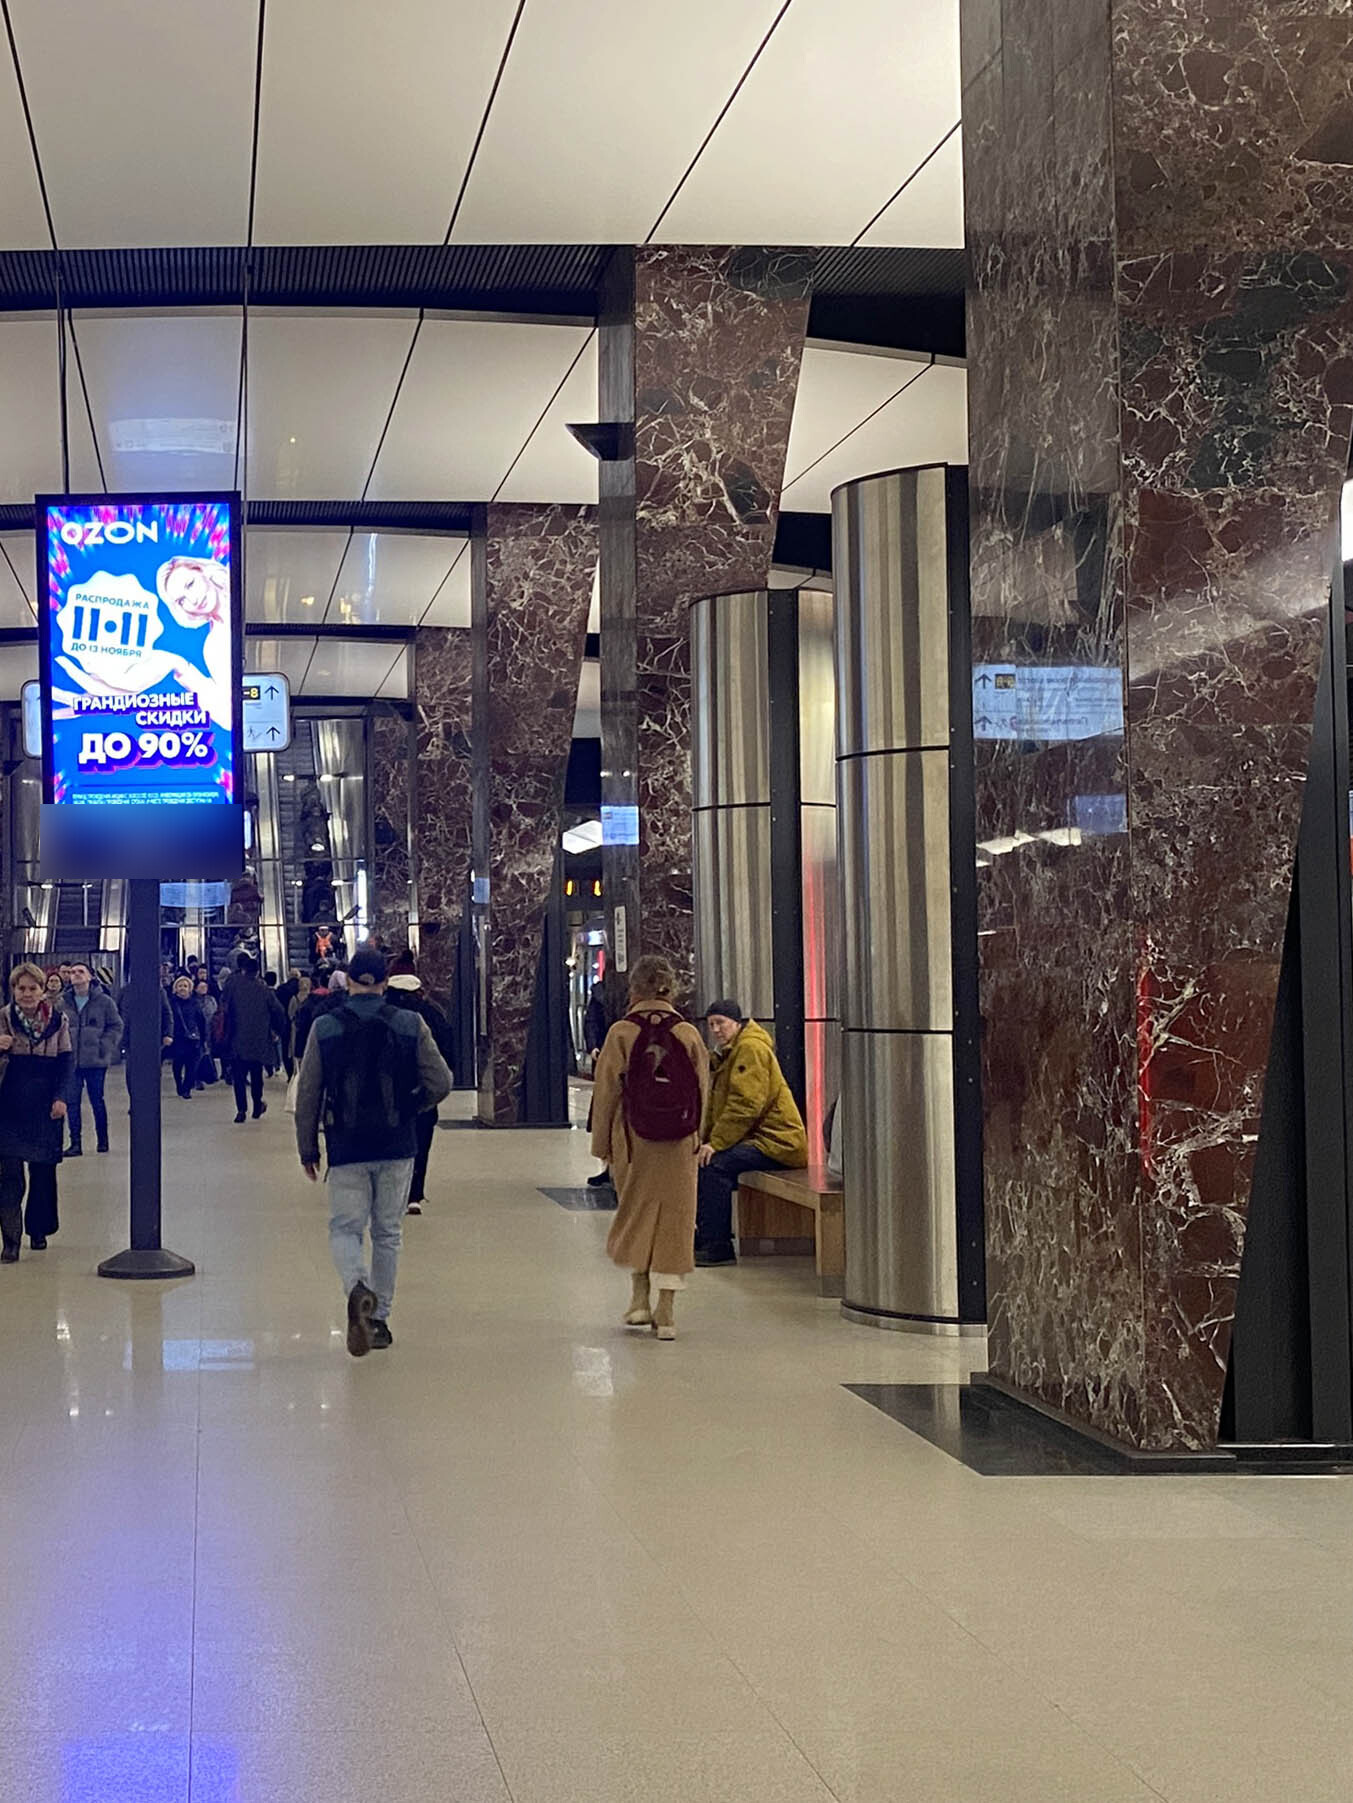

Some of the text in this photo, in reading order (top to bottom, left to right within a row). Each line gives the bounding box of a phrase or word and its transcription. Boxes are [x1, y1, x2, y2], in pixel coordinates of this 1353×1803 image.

[60, 520, 159, 545] OZON
[75, 593, 150, 609] РАСПРОДАЖА
[70, 642, 87, 652] ДО
[101, 646, 143, 658] НОЯБРЯ
[73, 693, 195, 711] ГРАНДИОЗНЫЕ
[135, 711, 207, 727] СКИДКИ
[78, 731, 209, 765] ДО 90%
